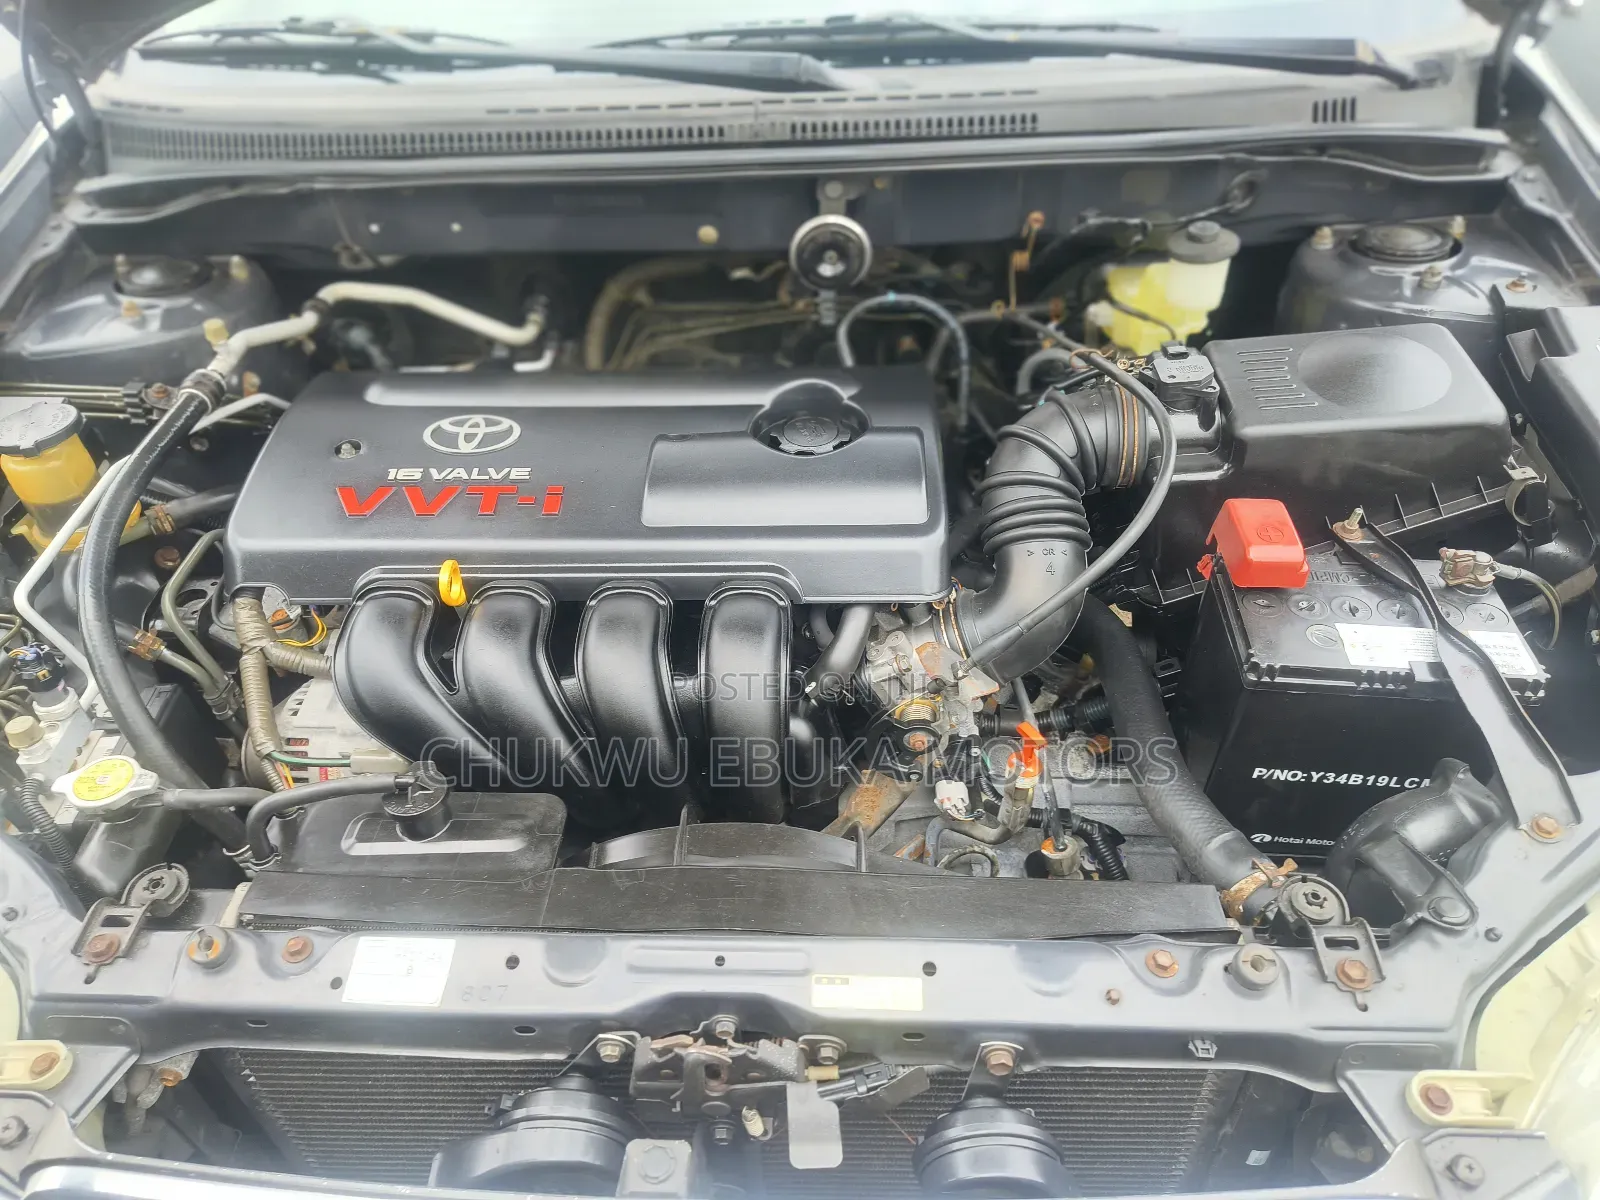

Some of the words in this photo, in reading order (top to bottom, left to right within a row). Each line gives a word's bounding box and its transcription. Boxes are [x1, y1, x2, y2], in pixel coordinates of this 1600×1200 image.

[387, 467, 424, 482] 16
[429, 467, 532, 482] VALVE
[335, 485, 565, 517] VVT-i
[1273, 836, 1304, 844] Hotai
[1305, 838, 1336, 846] Moto
